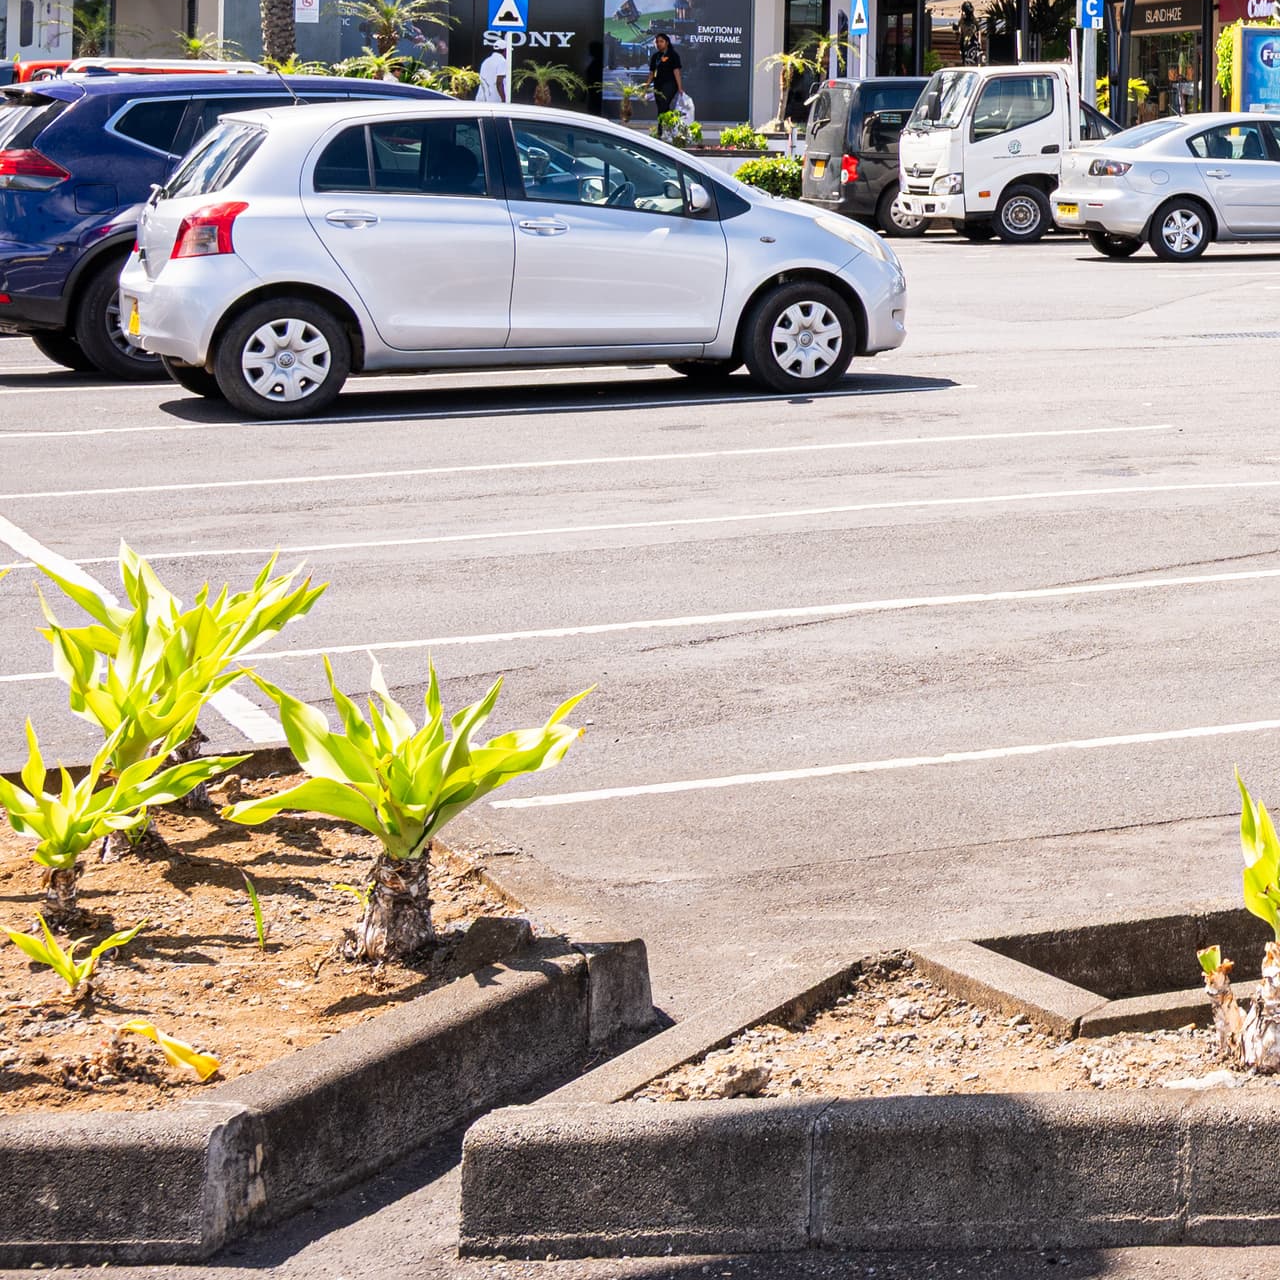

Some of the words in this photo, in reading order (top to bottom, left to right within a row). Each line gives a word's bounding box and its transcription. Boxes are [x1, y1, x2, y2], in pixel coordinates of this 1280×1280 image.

[698, 25, 733, 34] EMOTION
[734, 26, 742, 34] IN
[690, 35, 714, 43] EVERY
